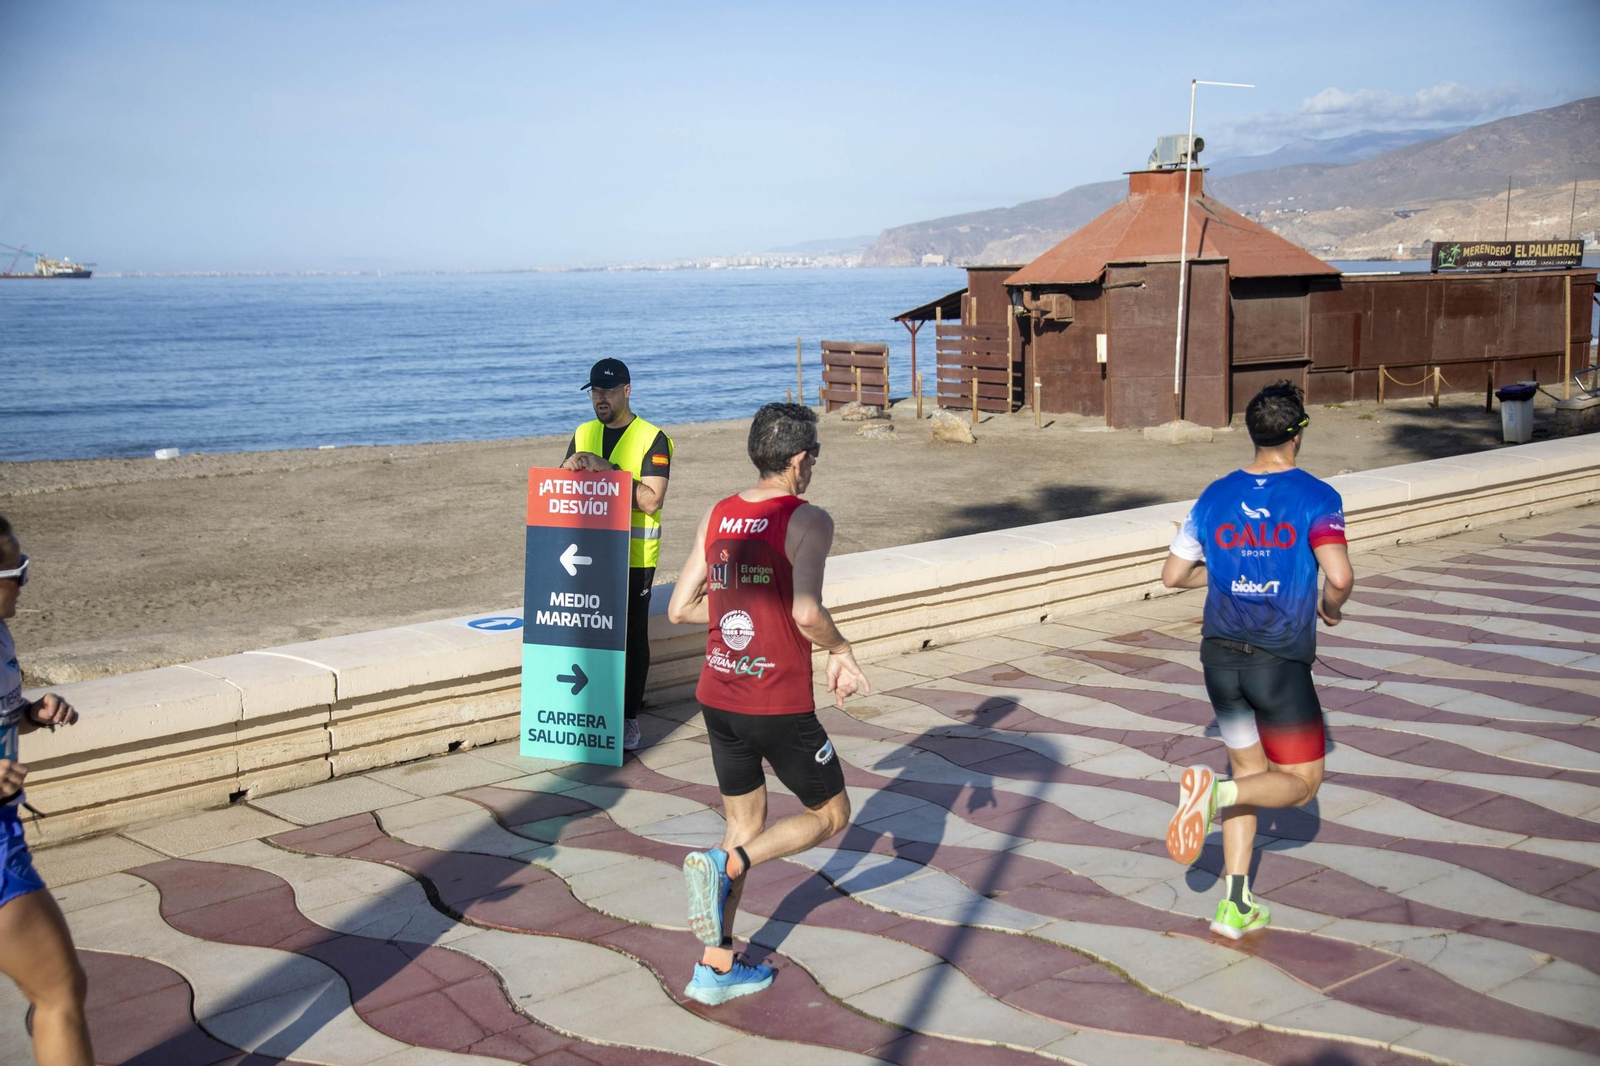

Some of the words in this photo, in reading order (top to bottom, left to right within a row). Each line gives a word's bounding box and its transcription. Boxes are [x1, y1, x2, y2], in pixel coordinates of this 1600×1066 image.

[1463, 243, 1511, 257] MERENDERO
[1515, 244, 1527, 258] EL
[1529, 243, 1581, 257] PALMERAL
[539, 478, 620, 497] ¡ATENCIÓN
[549, 498, 608, 516] DESVÍO!
[718, 516, 769, 534] MATEO
[1214, 522, 1297, 549] GALO
[741, 564, 748, 573] El
[741, 575, 751, 583] del
[753, 575, 770, 584] BIO
[549, 591, 600, 609] MEDIO
[536, 610, 613, 629] MARATÓN
[537, 710, 607, 729] CARRERA
[528, 728, 615, 750] SALUDABLE
